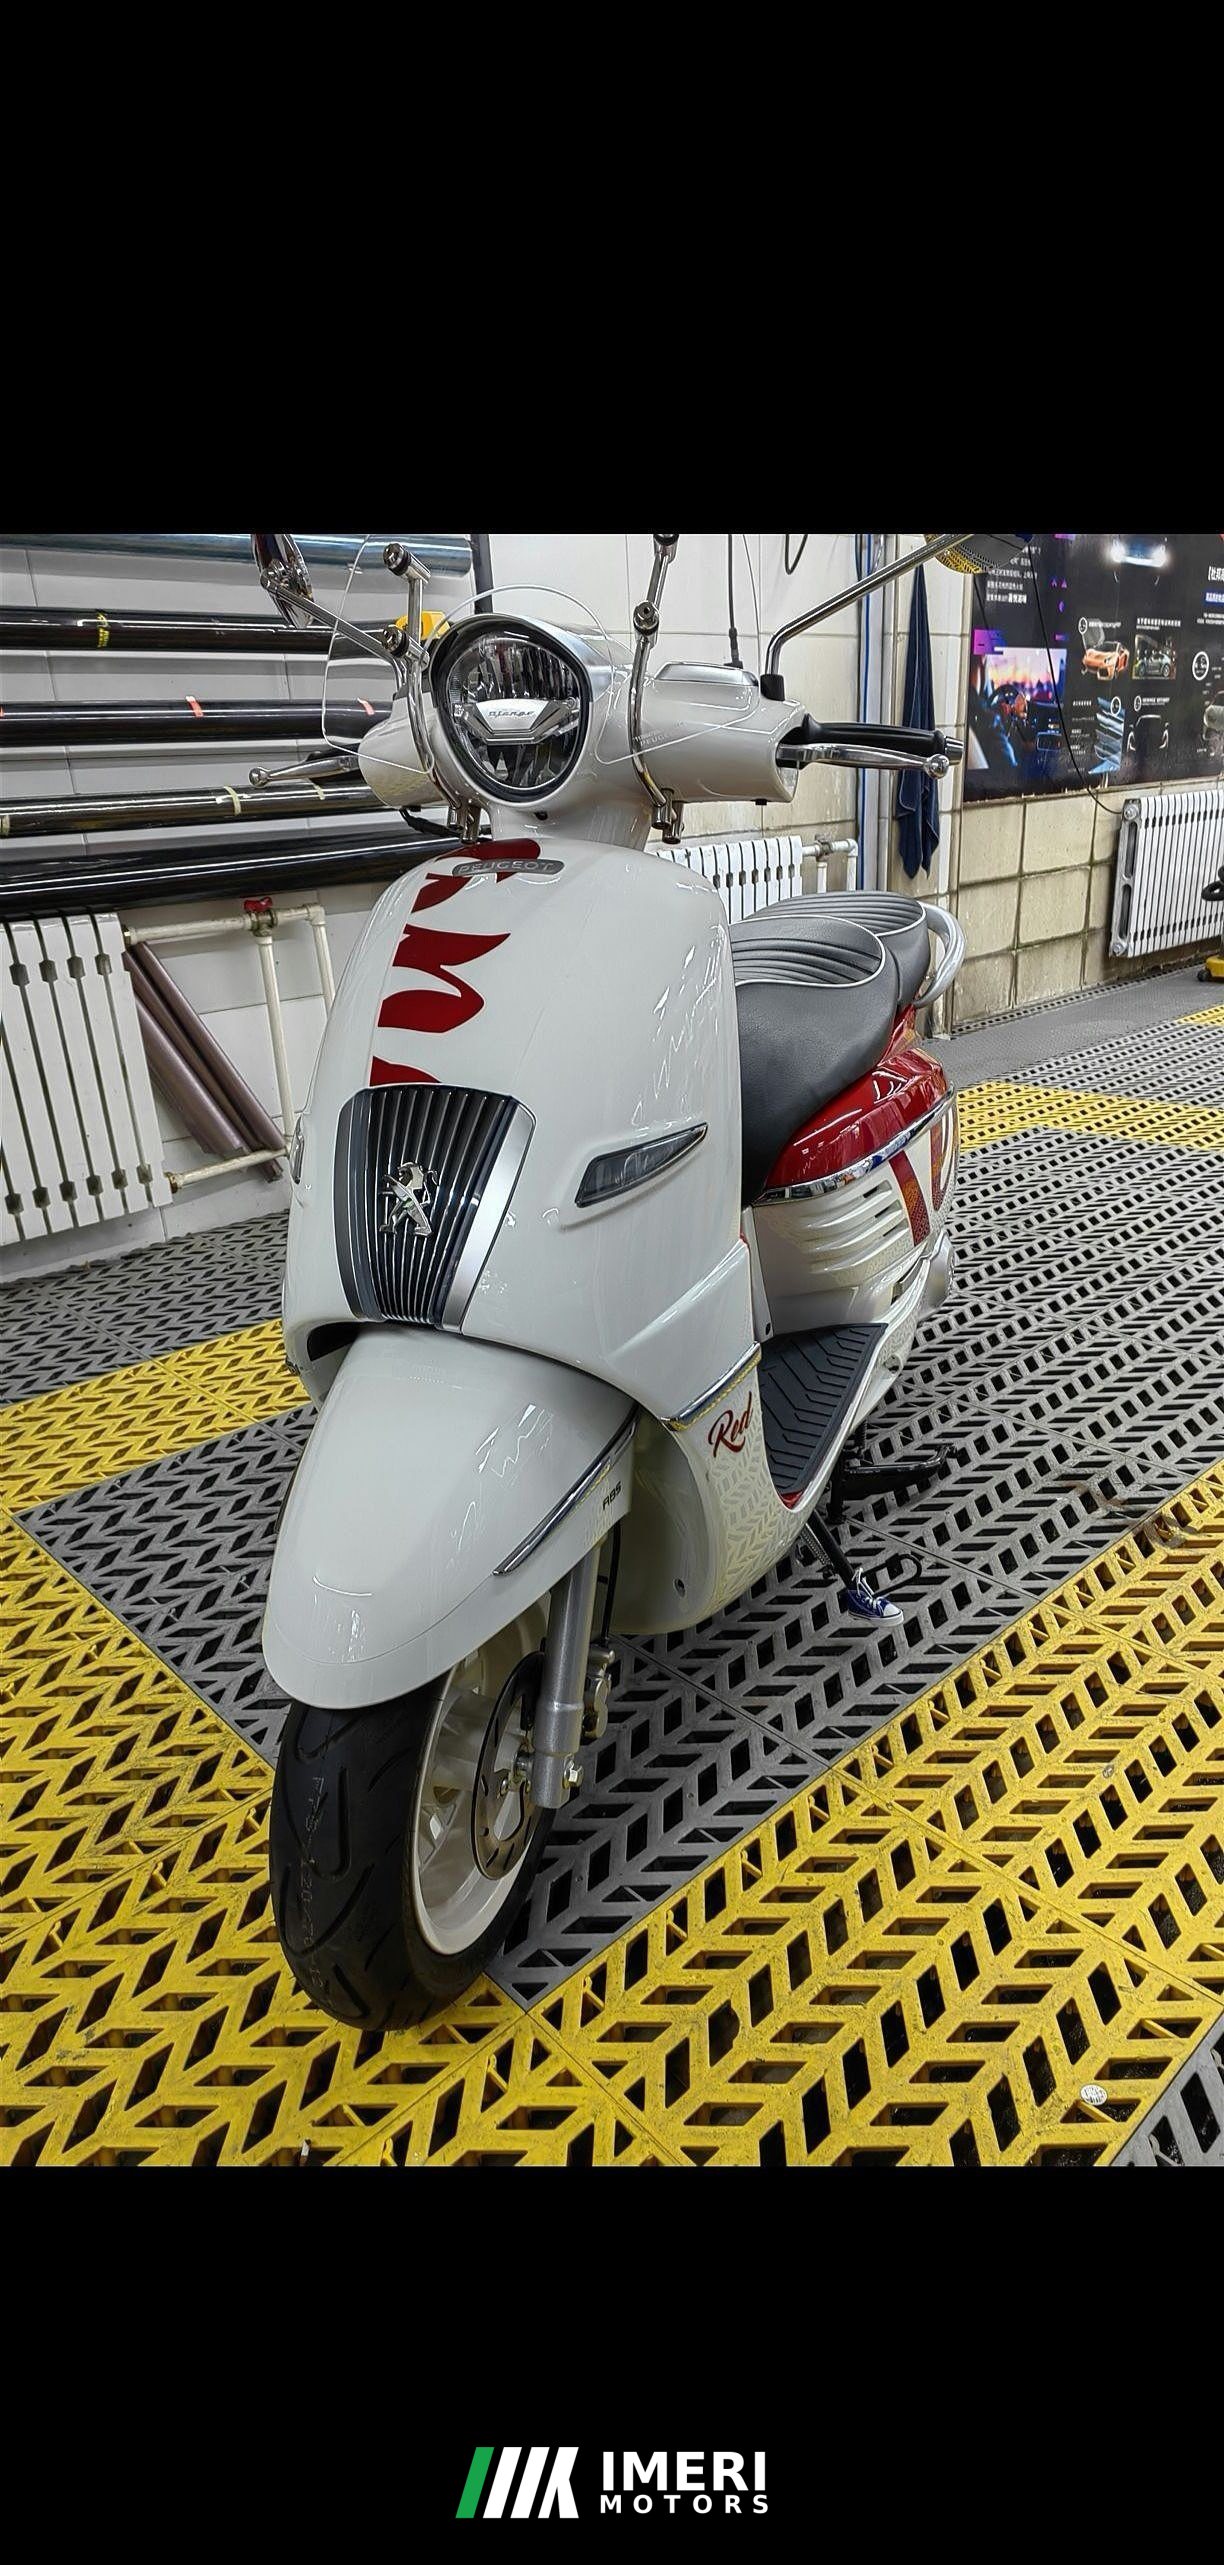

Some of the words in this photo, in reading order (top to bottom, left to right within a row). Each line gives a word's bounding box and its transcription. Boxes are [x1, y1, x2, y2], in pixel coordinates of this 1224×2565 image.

[458, 861, 555, 874] PEUGEOT
[708, 1391, 753, 1458] Red
[602, 1481, 622, 1510] ABS
